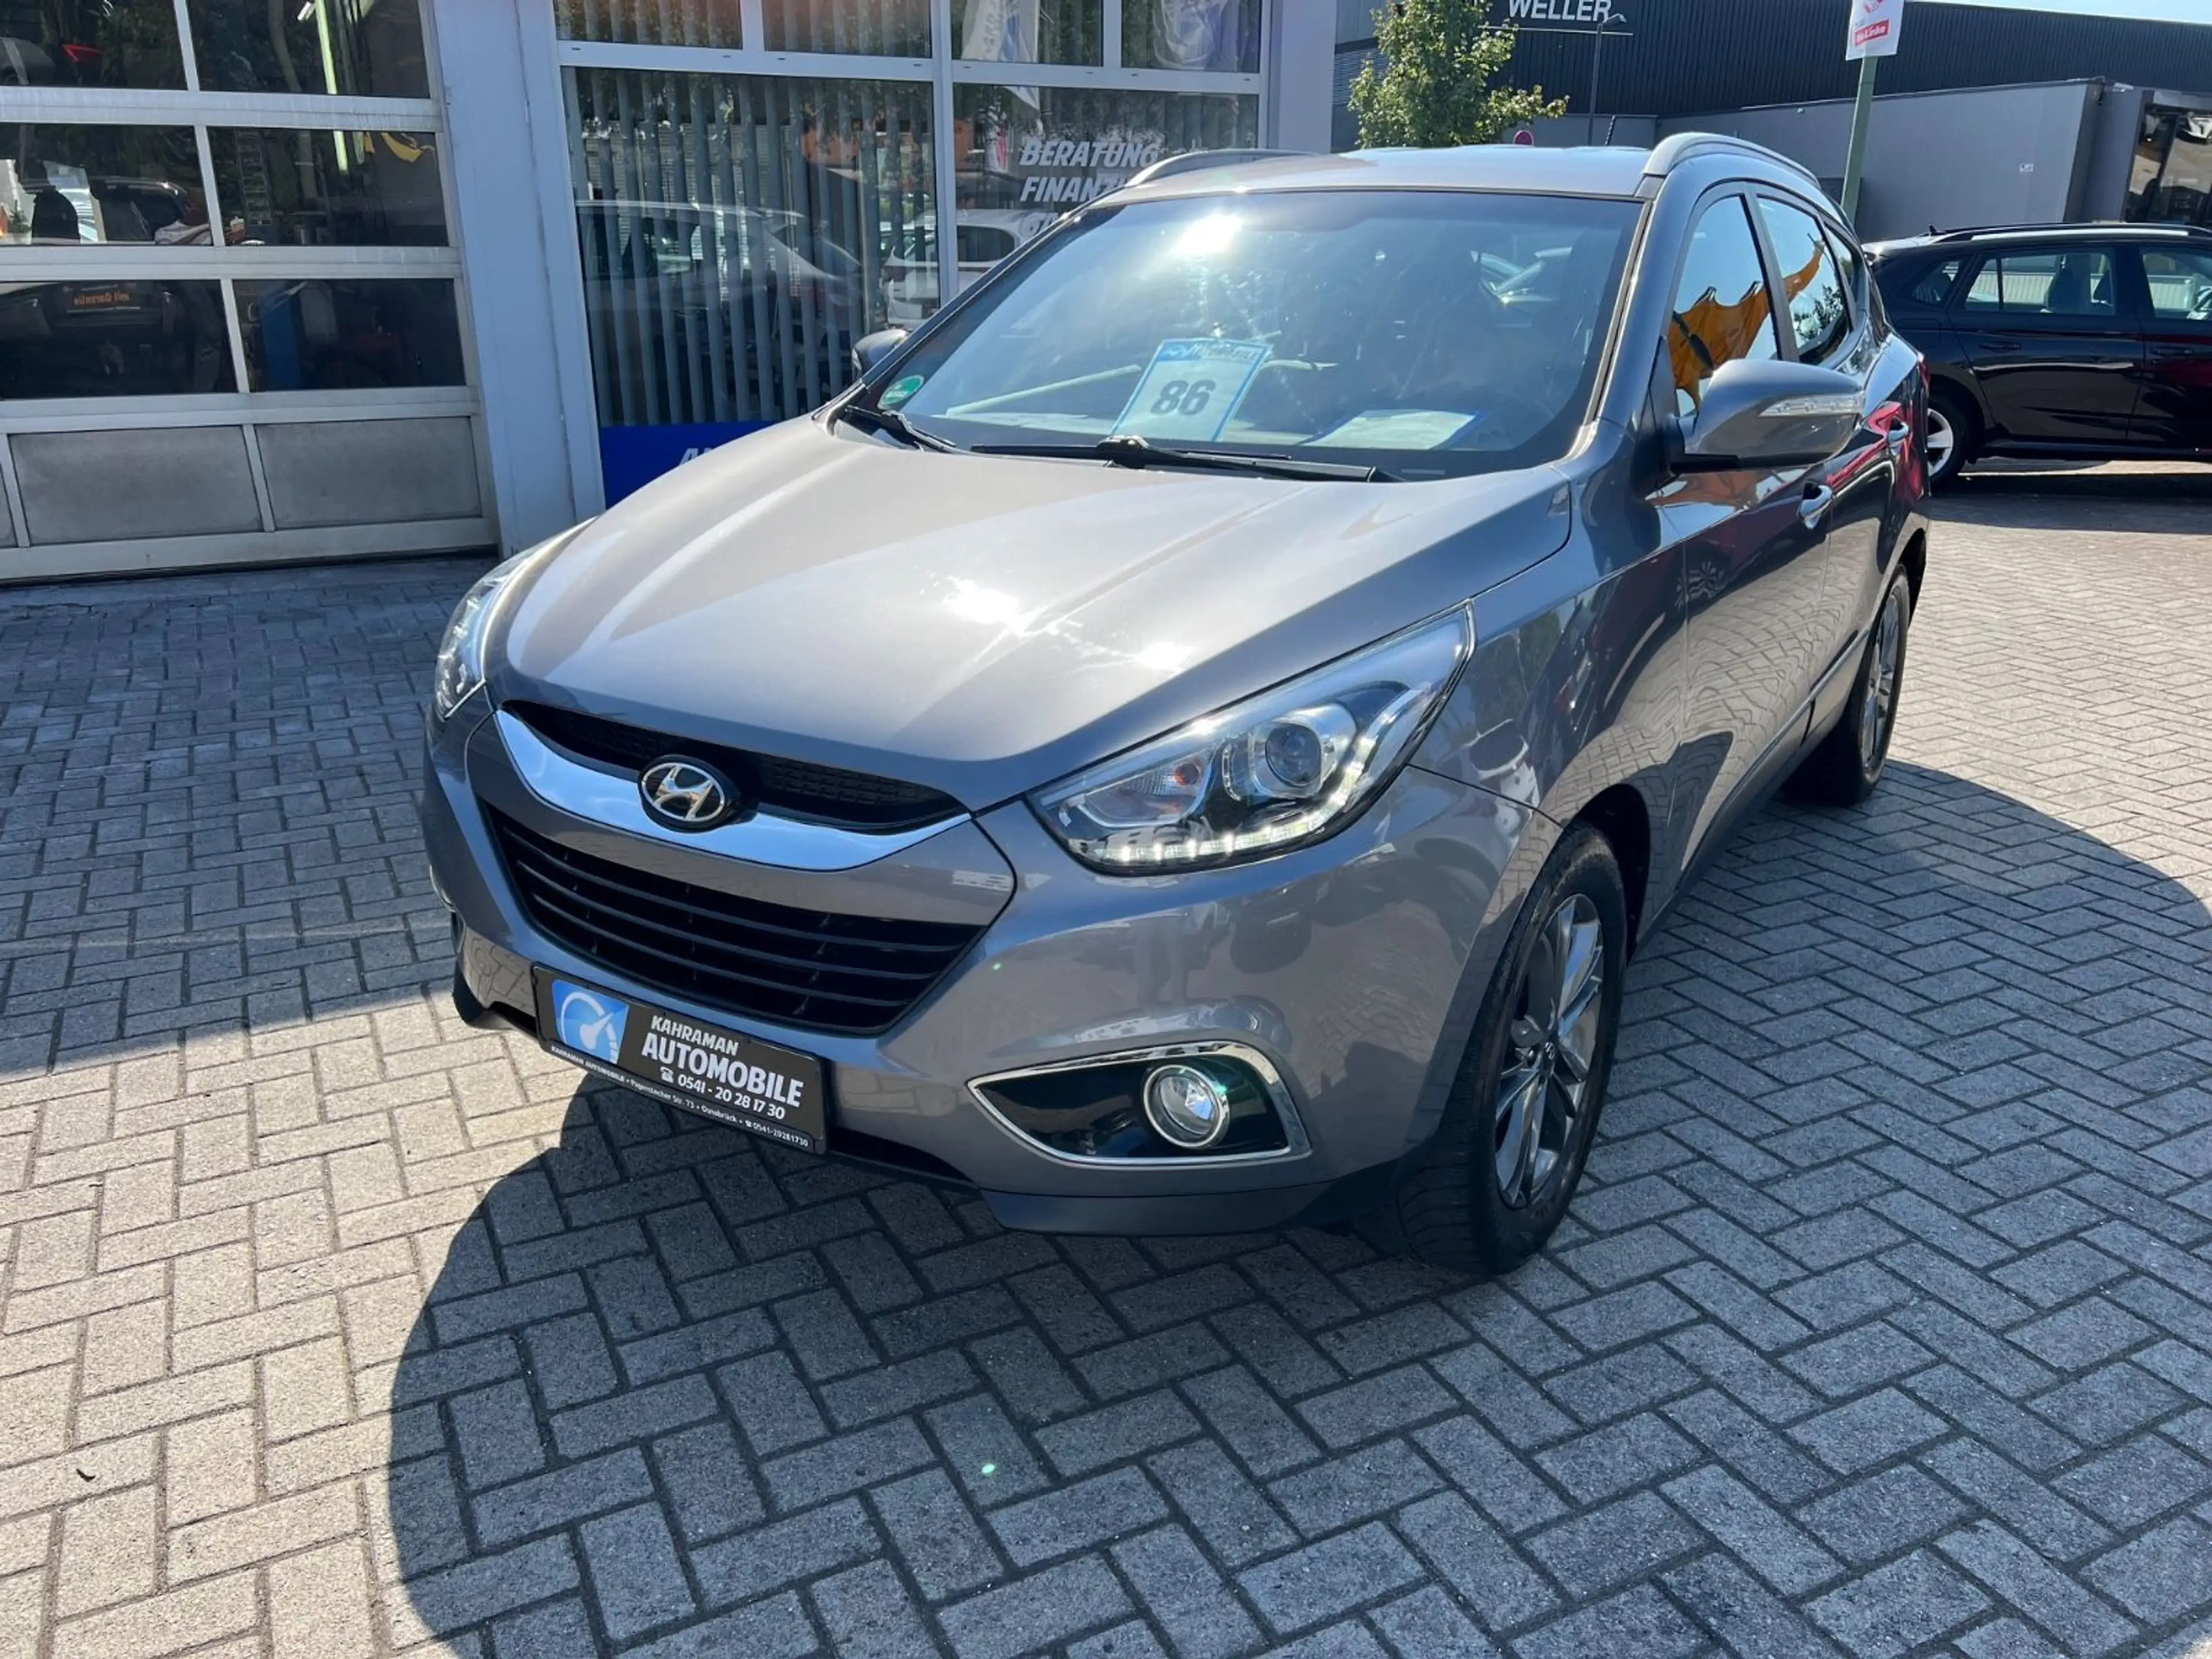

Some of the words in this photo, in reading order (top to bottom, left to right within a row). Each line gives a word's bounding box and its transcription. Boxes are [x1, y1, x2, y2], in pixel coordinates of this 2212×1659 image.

[1509, 0, 1611, 21] WELLER
[1019, 140, 1160, 168] BERATUNG
[1150, 380, 1216, 415] 86
[650, 1015, 738, 1056] KAHRAMAN
[641, 1032, 804, 1108] AUTOMOBILE
[677, 1074, 706, 1094] 0541
[714, 1086, 732, 1103] 20
[734, 1092, 751, 1109] 28
[752, 1099, 766, 1113] 17
[767, 1103, 786, 1120] 30
